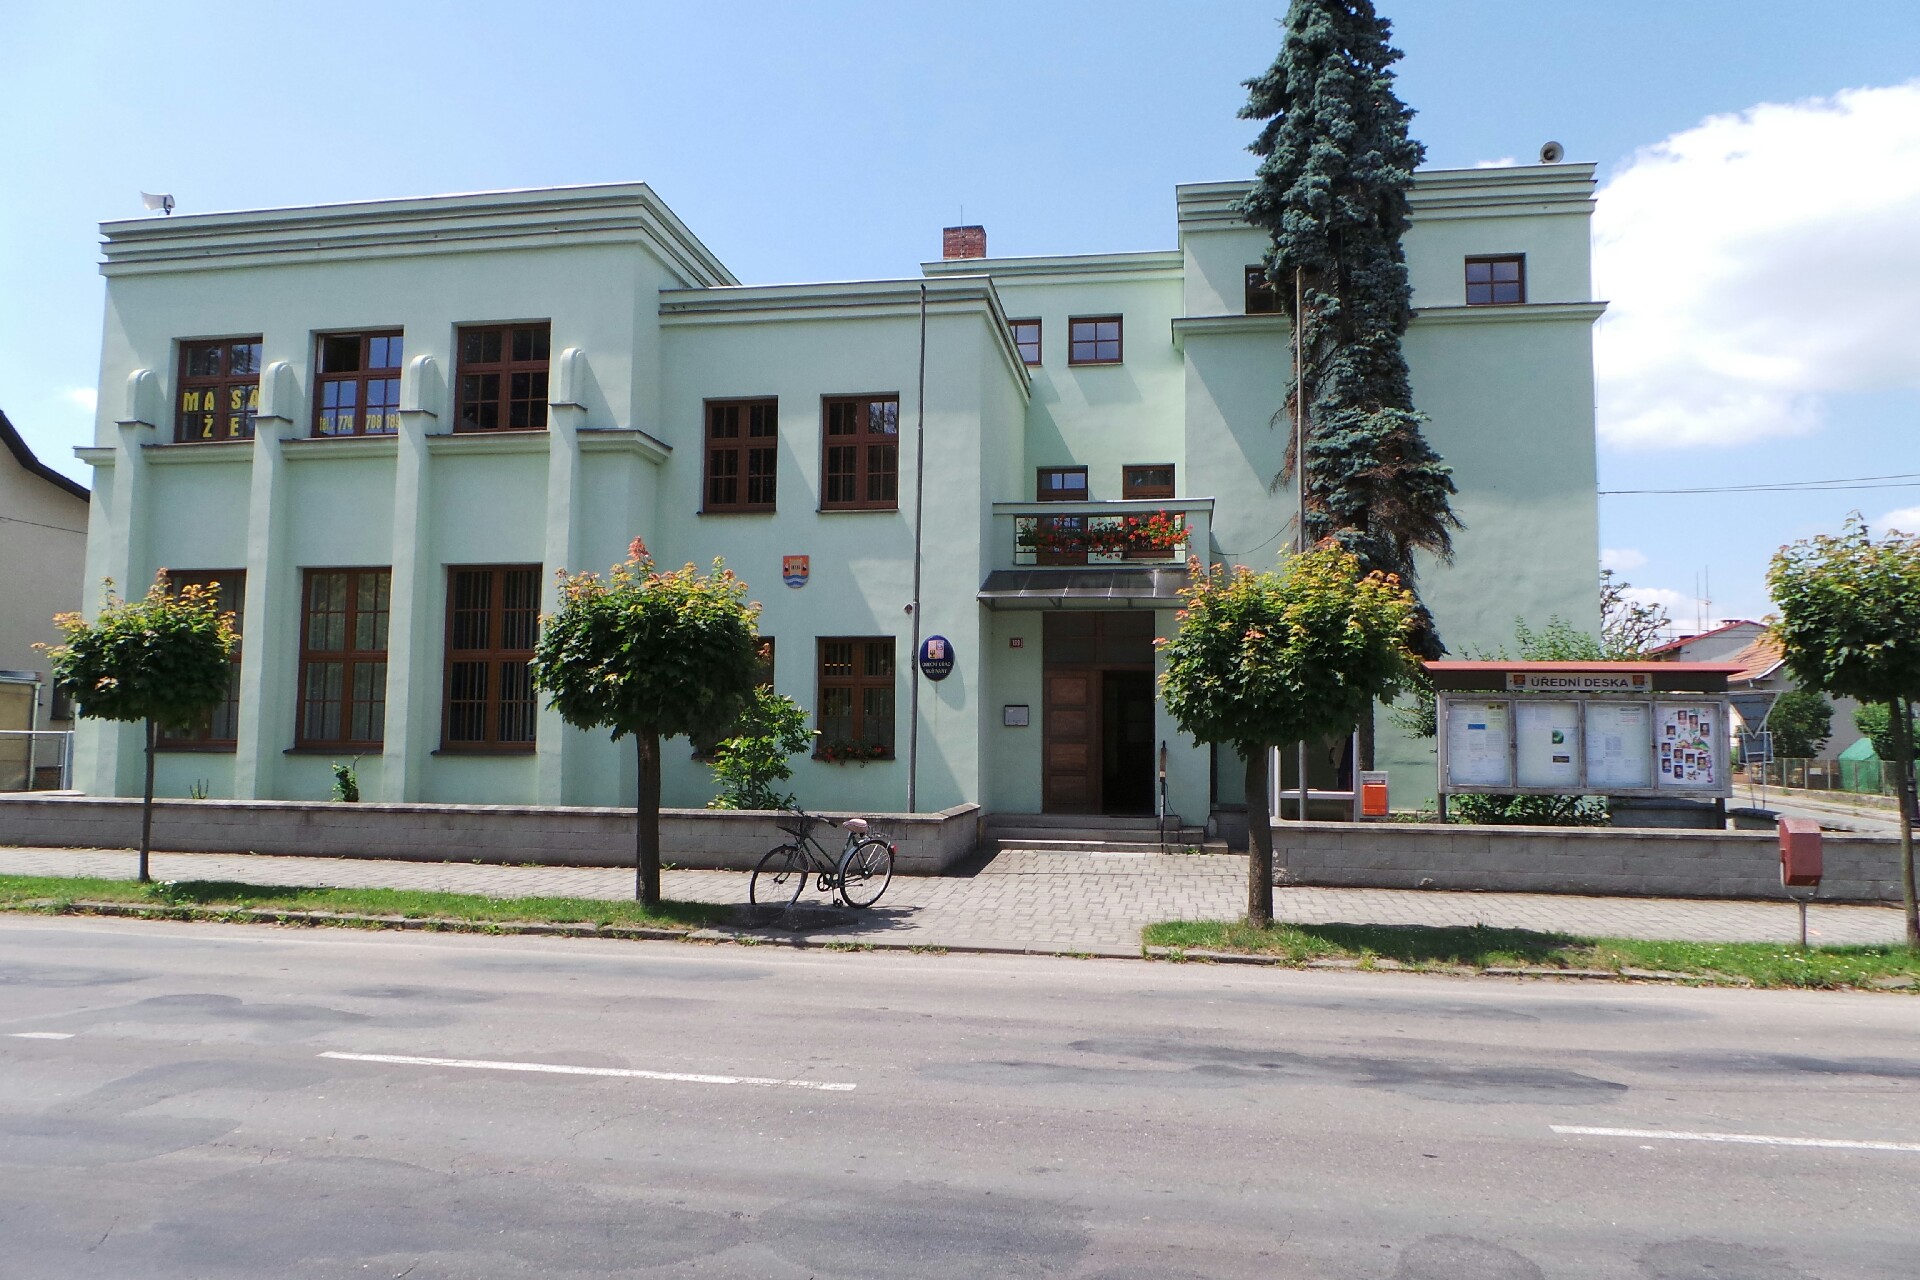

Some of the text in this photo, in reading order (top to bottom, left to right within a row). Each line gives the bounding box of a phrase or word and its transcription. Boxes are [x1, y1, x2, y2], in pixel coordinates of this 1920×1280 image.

[366, 414, 383, 430] 708
[1531, 676, 1629, 687] ÚŘEDNÍ DESKA
